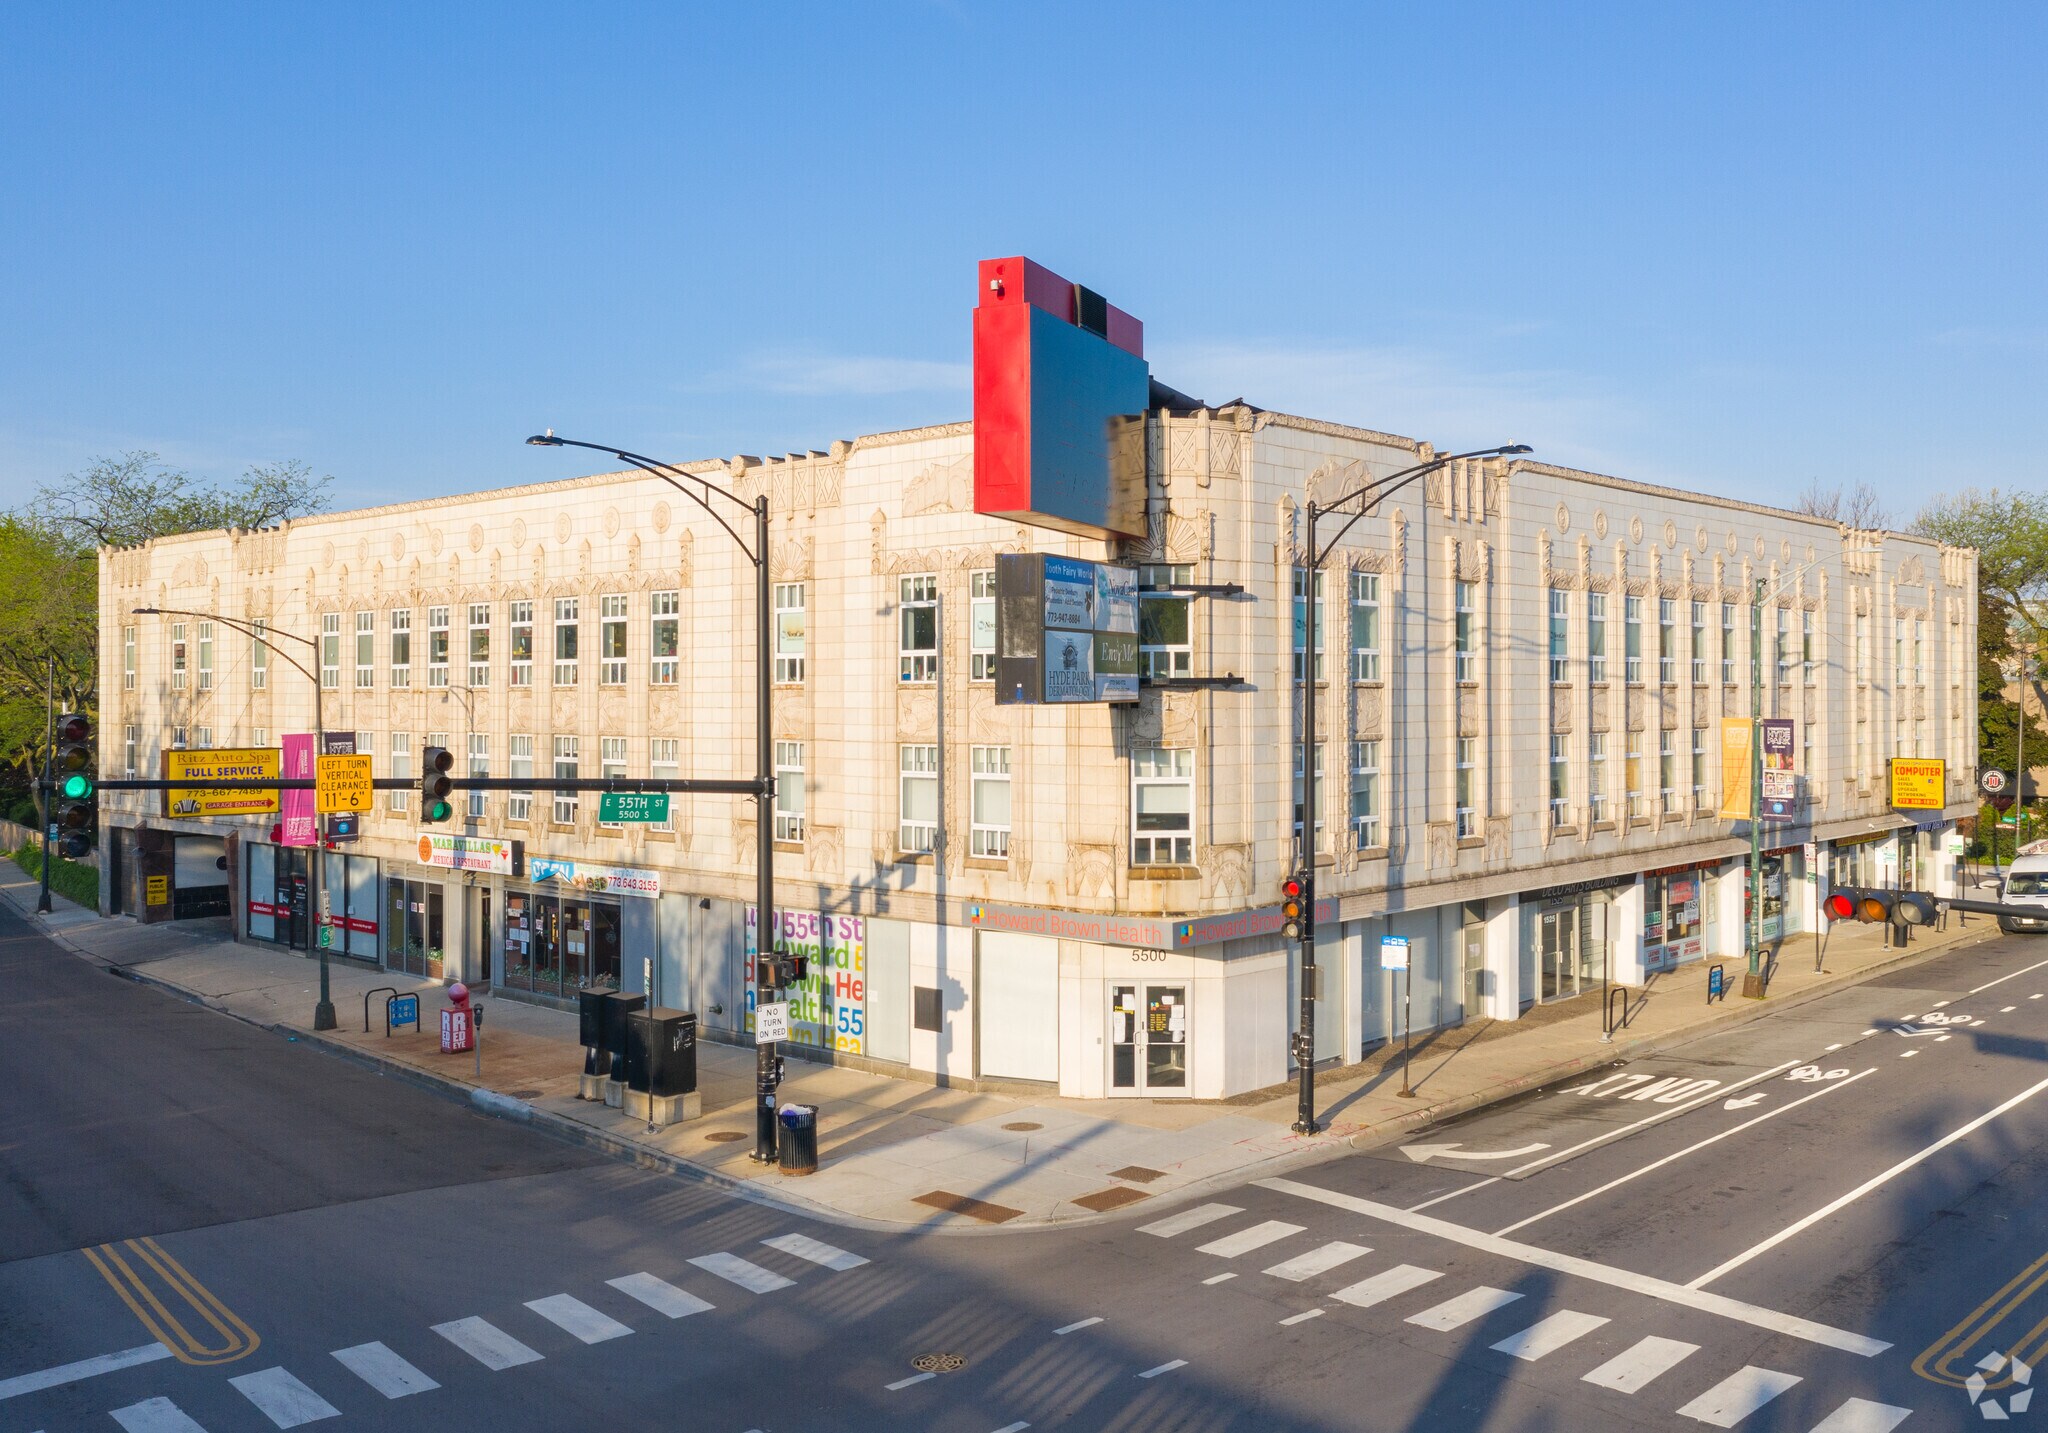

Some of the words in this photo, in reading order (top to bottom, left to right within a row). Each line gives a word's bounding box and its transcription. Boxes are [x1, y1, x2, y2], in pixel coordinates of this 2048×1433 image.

[1045, 563, 1061, 575] Tooth
[1063, 565, 1077, 579] Fairy
[1123, 643, 1134, 661] Me
[1049, 671, 1071, 686] HYDE
[1072, 671, 1090, 686] PARK
[1048, 685, 1090, 697] DERMATOLOGY
[177, 753, 206, 763] Ritz
[211, 752, 243, 762] Auto
[249, 751, 271, 764] Spa
[322, 761, 341, 770] LEFT
[347, 760, 367, 769] TURN
[1895, 766, 1940, 776] COMPUTER
[185, 768, 213, 778] FULL
[217, 766, 264, 777] SERVICE
[326, 771, 364, 780] VERTICAL
[321, 781, 369, 791] CLEARANCE
[186, 788, 263, 798] 773-667-7489
[206, 801, 235, 809] GARAGE
[235, 800, 268, 808] ENTRANCE
[606, 798, 611, 807] E
[618, 797, 648, 809] 55TH
[655, 799, 664, 807] ST
[619, 811, 640, 819] 5500
[644, 811, 650, 819] S
[432, 837, 492, 854] MARAVILLAS
[432, 855, 456, 866] MEXICAN
[457, 857, 491, 870] RESTAURANT
[608, 876, 658, 891] 773.643.3155
[784, 911, 834, 940] 55th
[839, 916, 863, 942] St
[987, 908, 1046, 933] Howard
[1051, 915, 1100, 939] Brown
[1106, 922, 1162, 945] Health
[1195, 914, 1247, 943] Howard
[1250, 912, 1285, 934] Brow
[1131, 950, 1167, 962] 5500
[767, 1008, 778, 1016] NO
[764, 1019, 782, 1027] TURN
[773, 1028, 786, 1037] RED
[453, 1041, 466, 1050] EYE
[1557, 1073, 1721, 1103] ONLY
